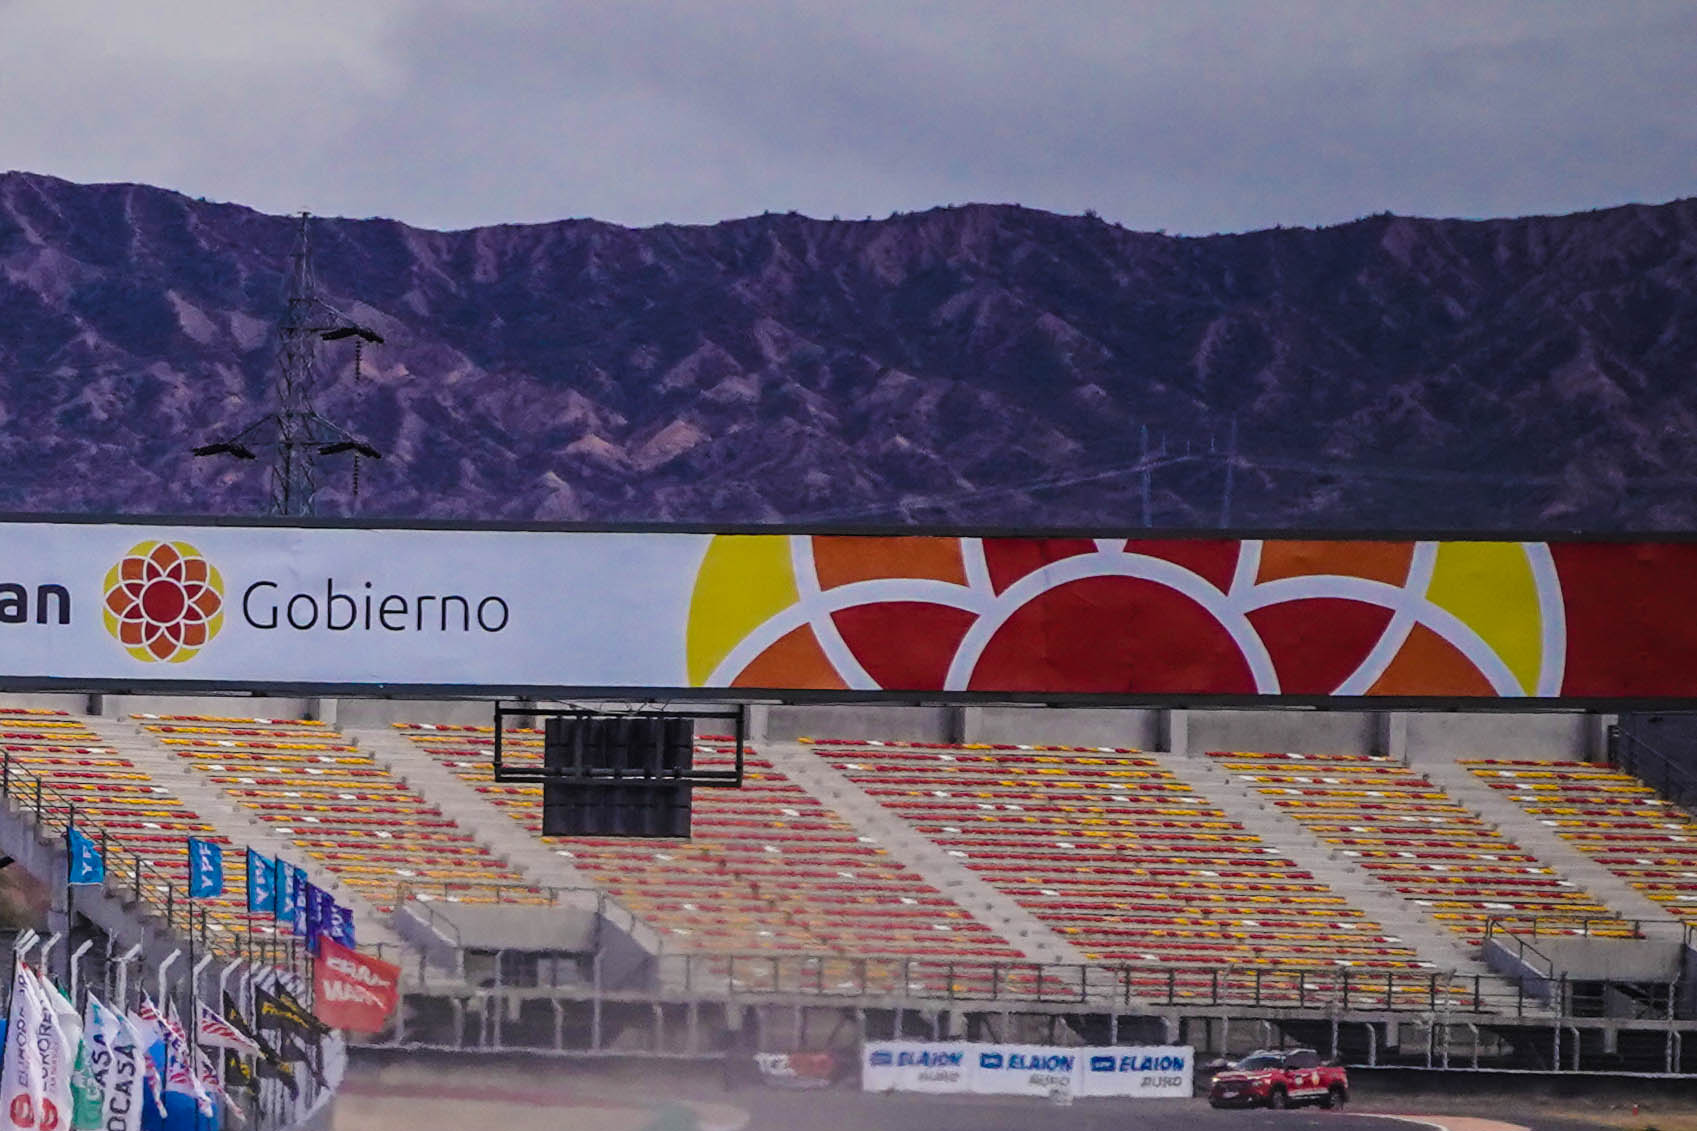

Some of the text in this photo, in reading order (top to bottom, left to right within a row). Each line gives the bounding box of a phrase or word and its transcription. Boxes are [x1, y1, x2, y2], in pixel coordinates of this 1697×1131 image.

[243, 580, 509, 633] Gobierno
[1008, 1054, 1075, 1072] ELAION
[1120, 1056, 1185, 1072] ELAION
